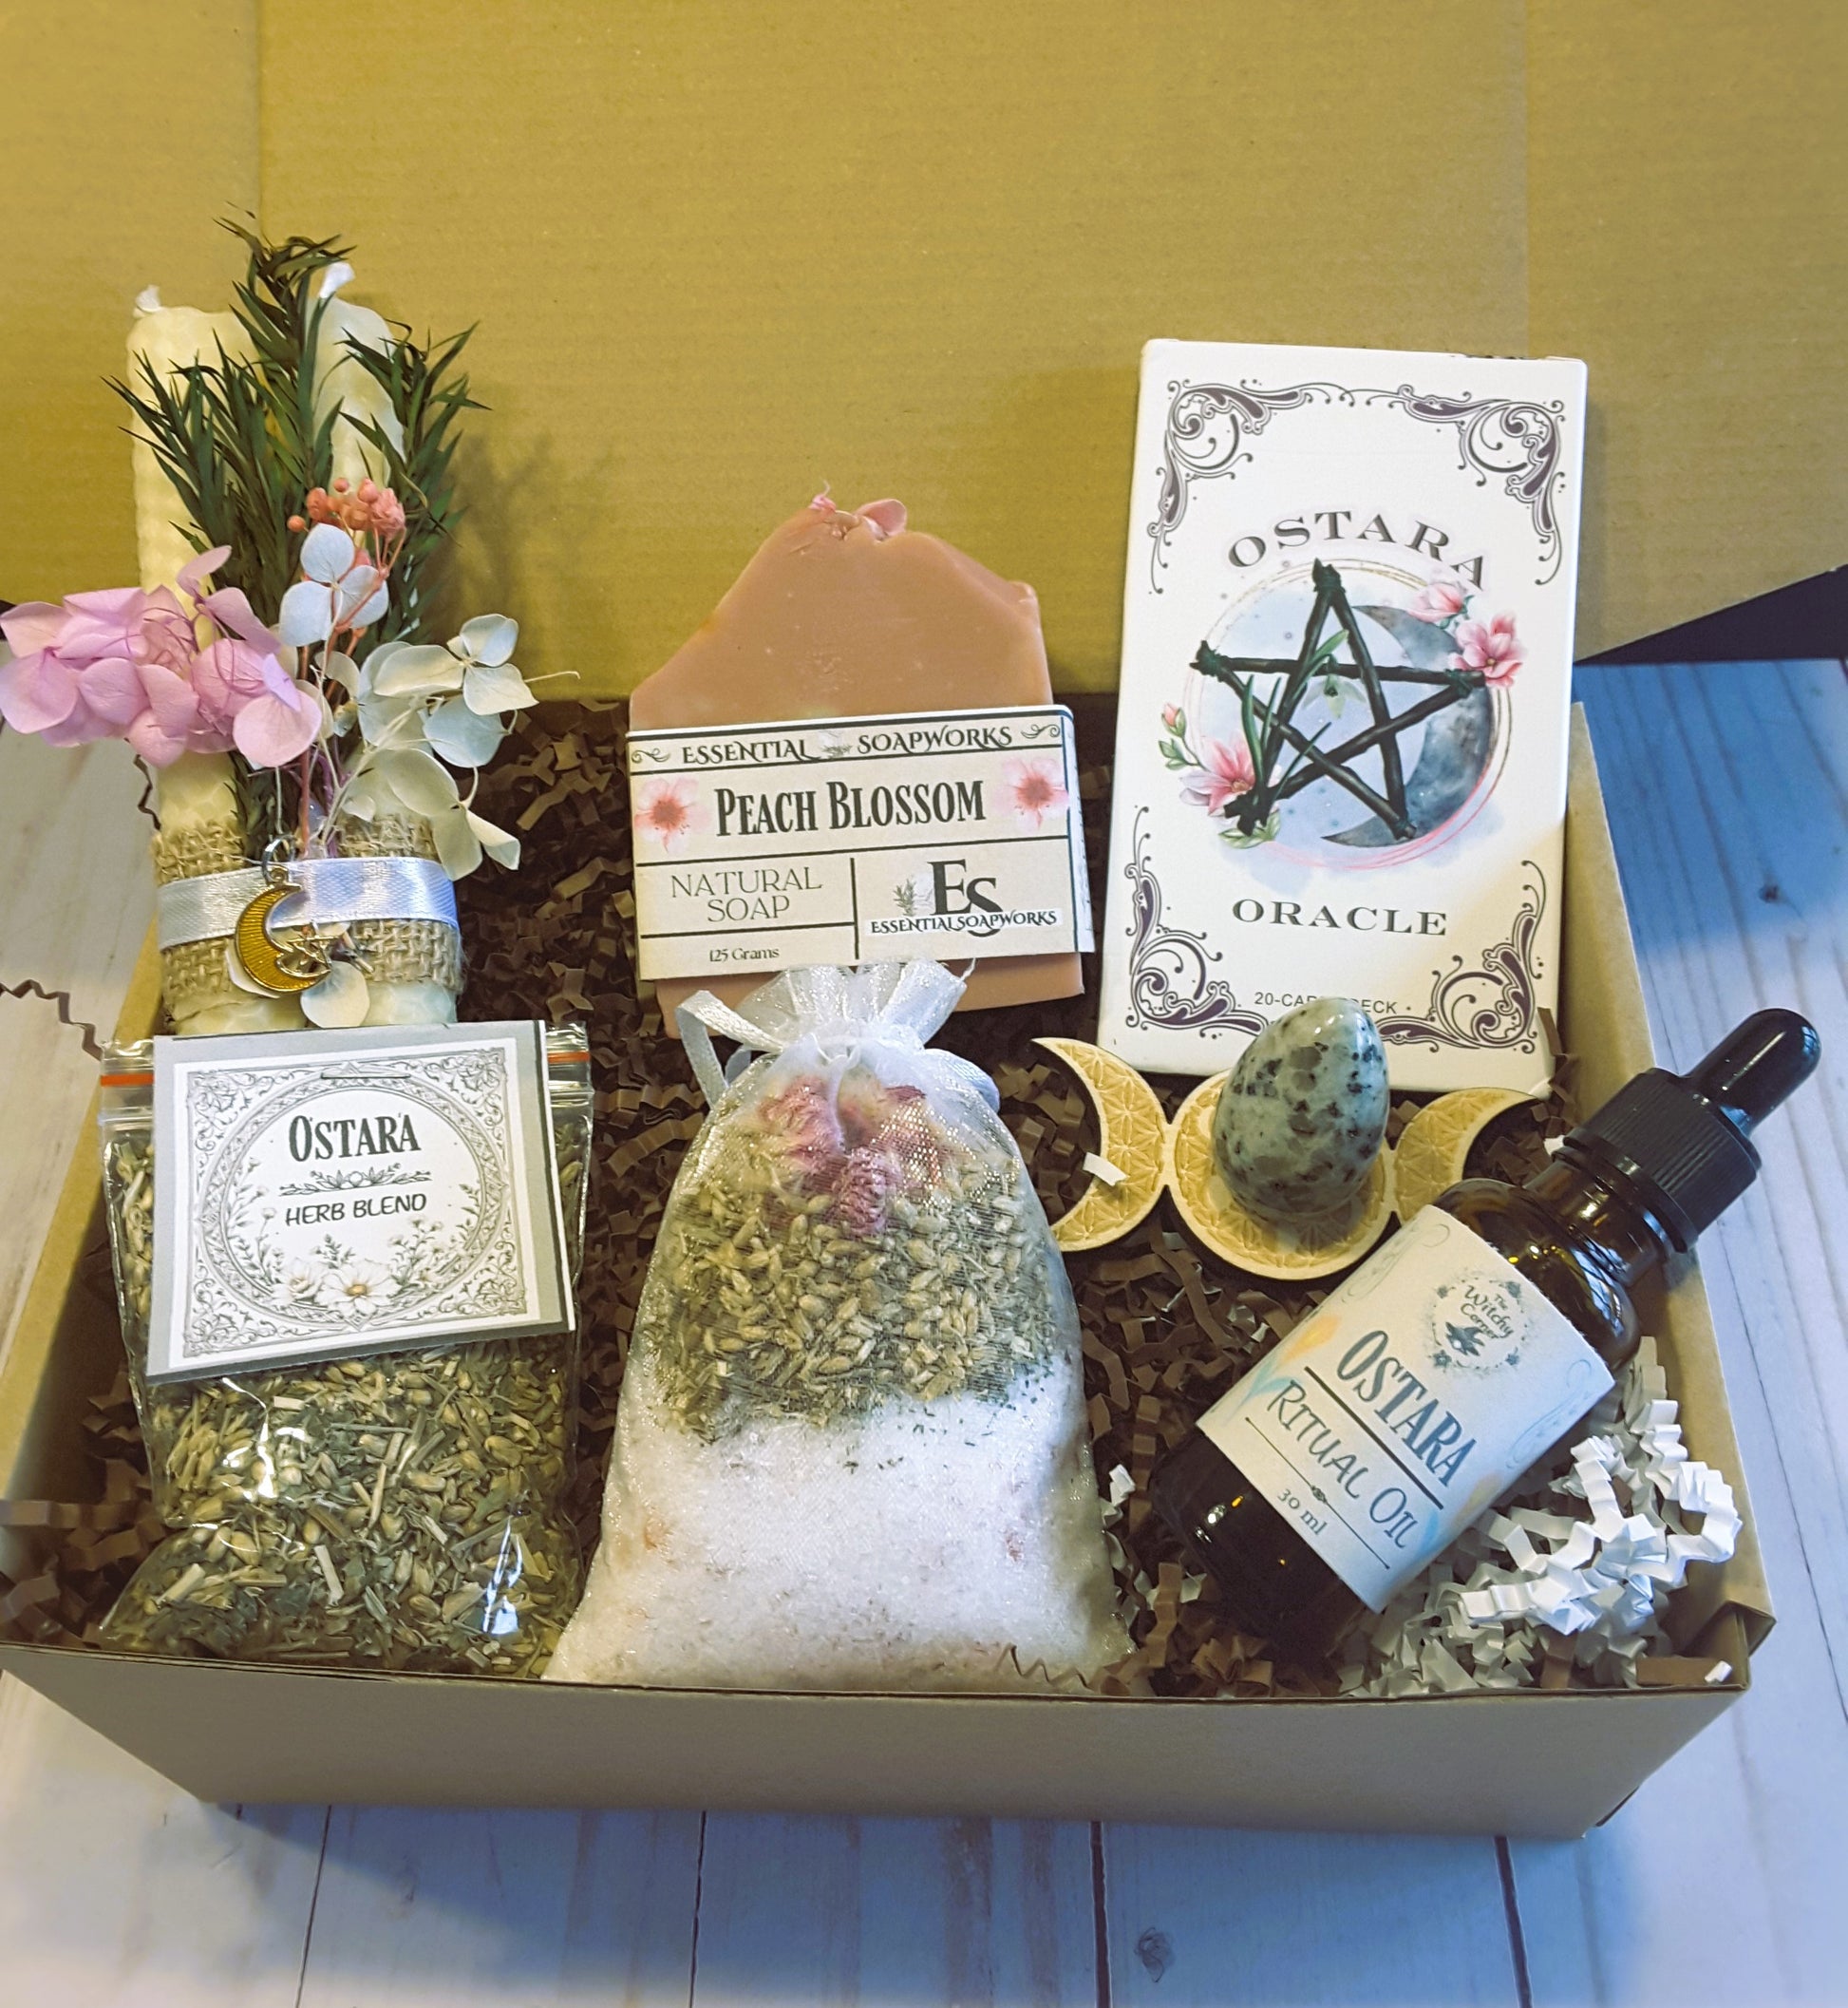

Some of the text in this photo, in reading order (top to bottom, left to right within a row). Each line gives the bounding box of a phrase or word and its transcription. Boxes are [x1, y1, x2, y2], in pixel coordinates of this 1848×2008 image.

[1228, 511, 1483, 591] OSTARA
[683, 726, 1013, 765] ESSENTIAL SOAPWORKS
[714, 780, 987, 837] PEACH BLOSSOM
[671, 866, 822, 899] NATURAL
[707, 895, 790, 922] SOAP
[1232, 898, 1447, 938] ORACLE
[708, 946, 780, 961] 125 Grams
[289, 1113, 421, 1163] OSTARA
[285, 1193, 427, 1226] HERB BLEND
[1464, 1284, 1514, 1338] Witchy
[1336, 1329, 1477, 1487] OSTARA
[1267, 1380, 1418, 1549] RITUAL OIL
[1277, 1488, 1329, 1537] 30 ml
